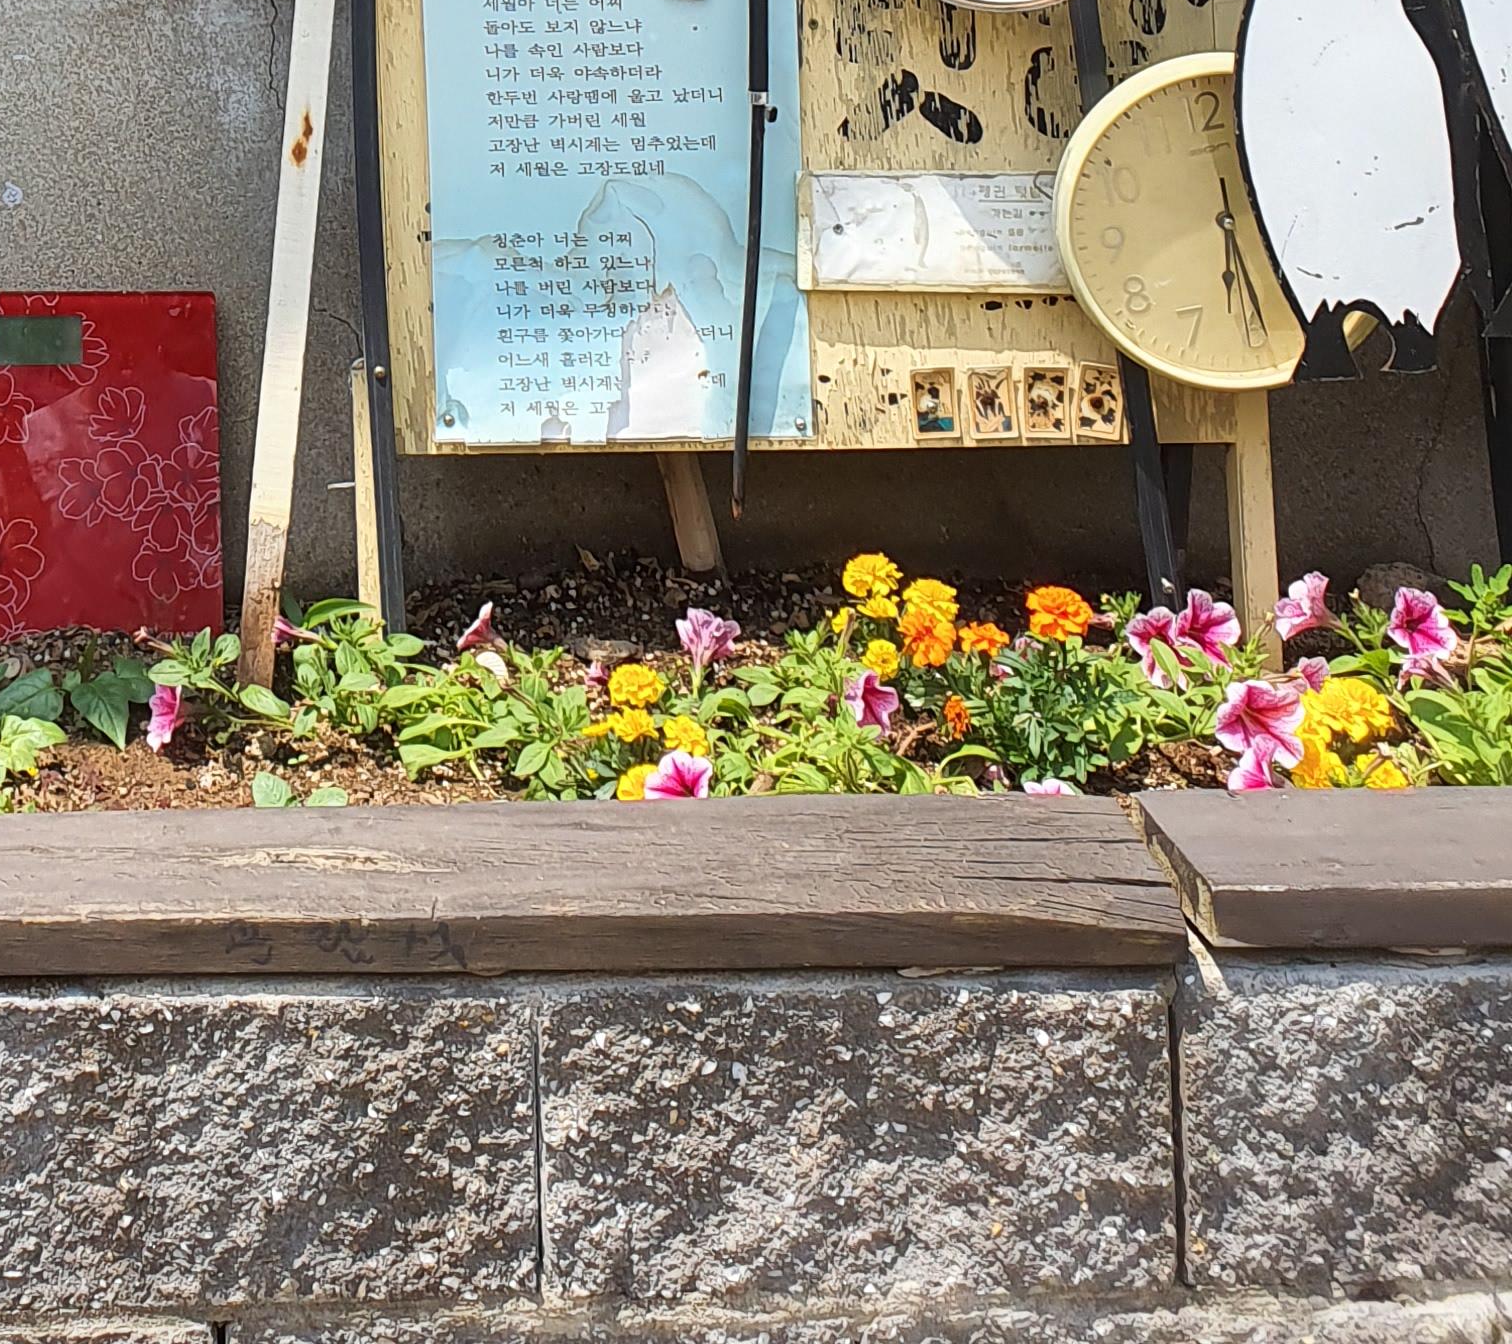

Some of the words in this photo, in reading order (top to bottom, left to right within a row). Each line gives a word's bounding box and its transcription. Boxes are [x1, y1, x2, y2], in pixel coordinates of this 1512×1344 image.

[483, 19, 536, 35] 돌아도
[544, 19, 579, 35] 보지
[589, 17, 643, 35] 않느냐
[484, 42, 519, 59] 나를
[527, 42, 564, 59] 속인
[572, 41, 644, 58] 사람보다
[485, 66, 520, 82] 니가
[530, 66, 565, 82] 더욱
[485, 90, 538, 106] 한두번
[627, 88, 664, 104] 울고
[672, 87, 724, 104] 났더니
[487, 113, 539, 129] 저만큼
[548, 112, 601, 129] 가버린
[611, 111, 647, 128] 세월
[488, 137, 540, 154] 고장난
[551, 136, 621, 153] 벽시계는
[630, 134, 717, 152] 멈추었는데
[489, 163, 506, 178] 저
[515, 161, 569, 178] 세월은
[577, 159, 665, 177] 고장도없네
[492, 232, 545, 249] 청춘아
[554, 231, 589, 248] 너는
[598, 231, 633, 248] 어찌
[493, 255, 544, 272] 모른척
[554, 255, 590, 271] 하고
[494, 280, 529, 296] 나를
[538, 279, 573, 296] 버린
[581, 278, 655, 295] 사람보다
[496, 303, 531, 320] 니가
[540, 303, 575, 319] 더욱
[497, 351, 549, 368] 어느새
[559, 351, 612, 368] 흘러간
[498, 375, 552, 393] 고장난
[500, 401, 516, 417] 저
[525, 399, 579, 417] 세월은
